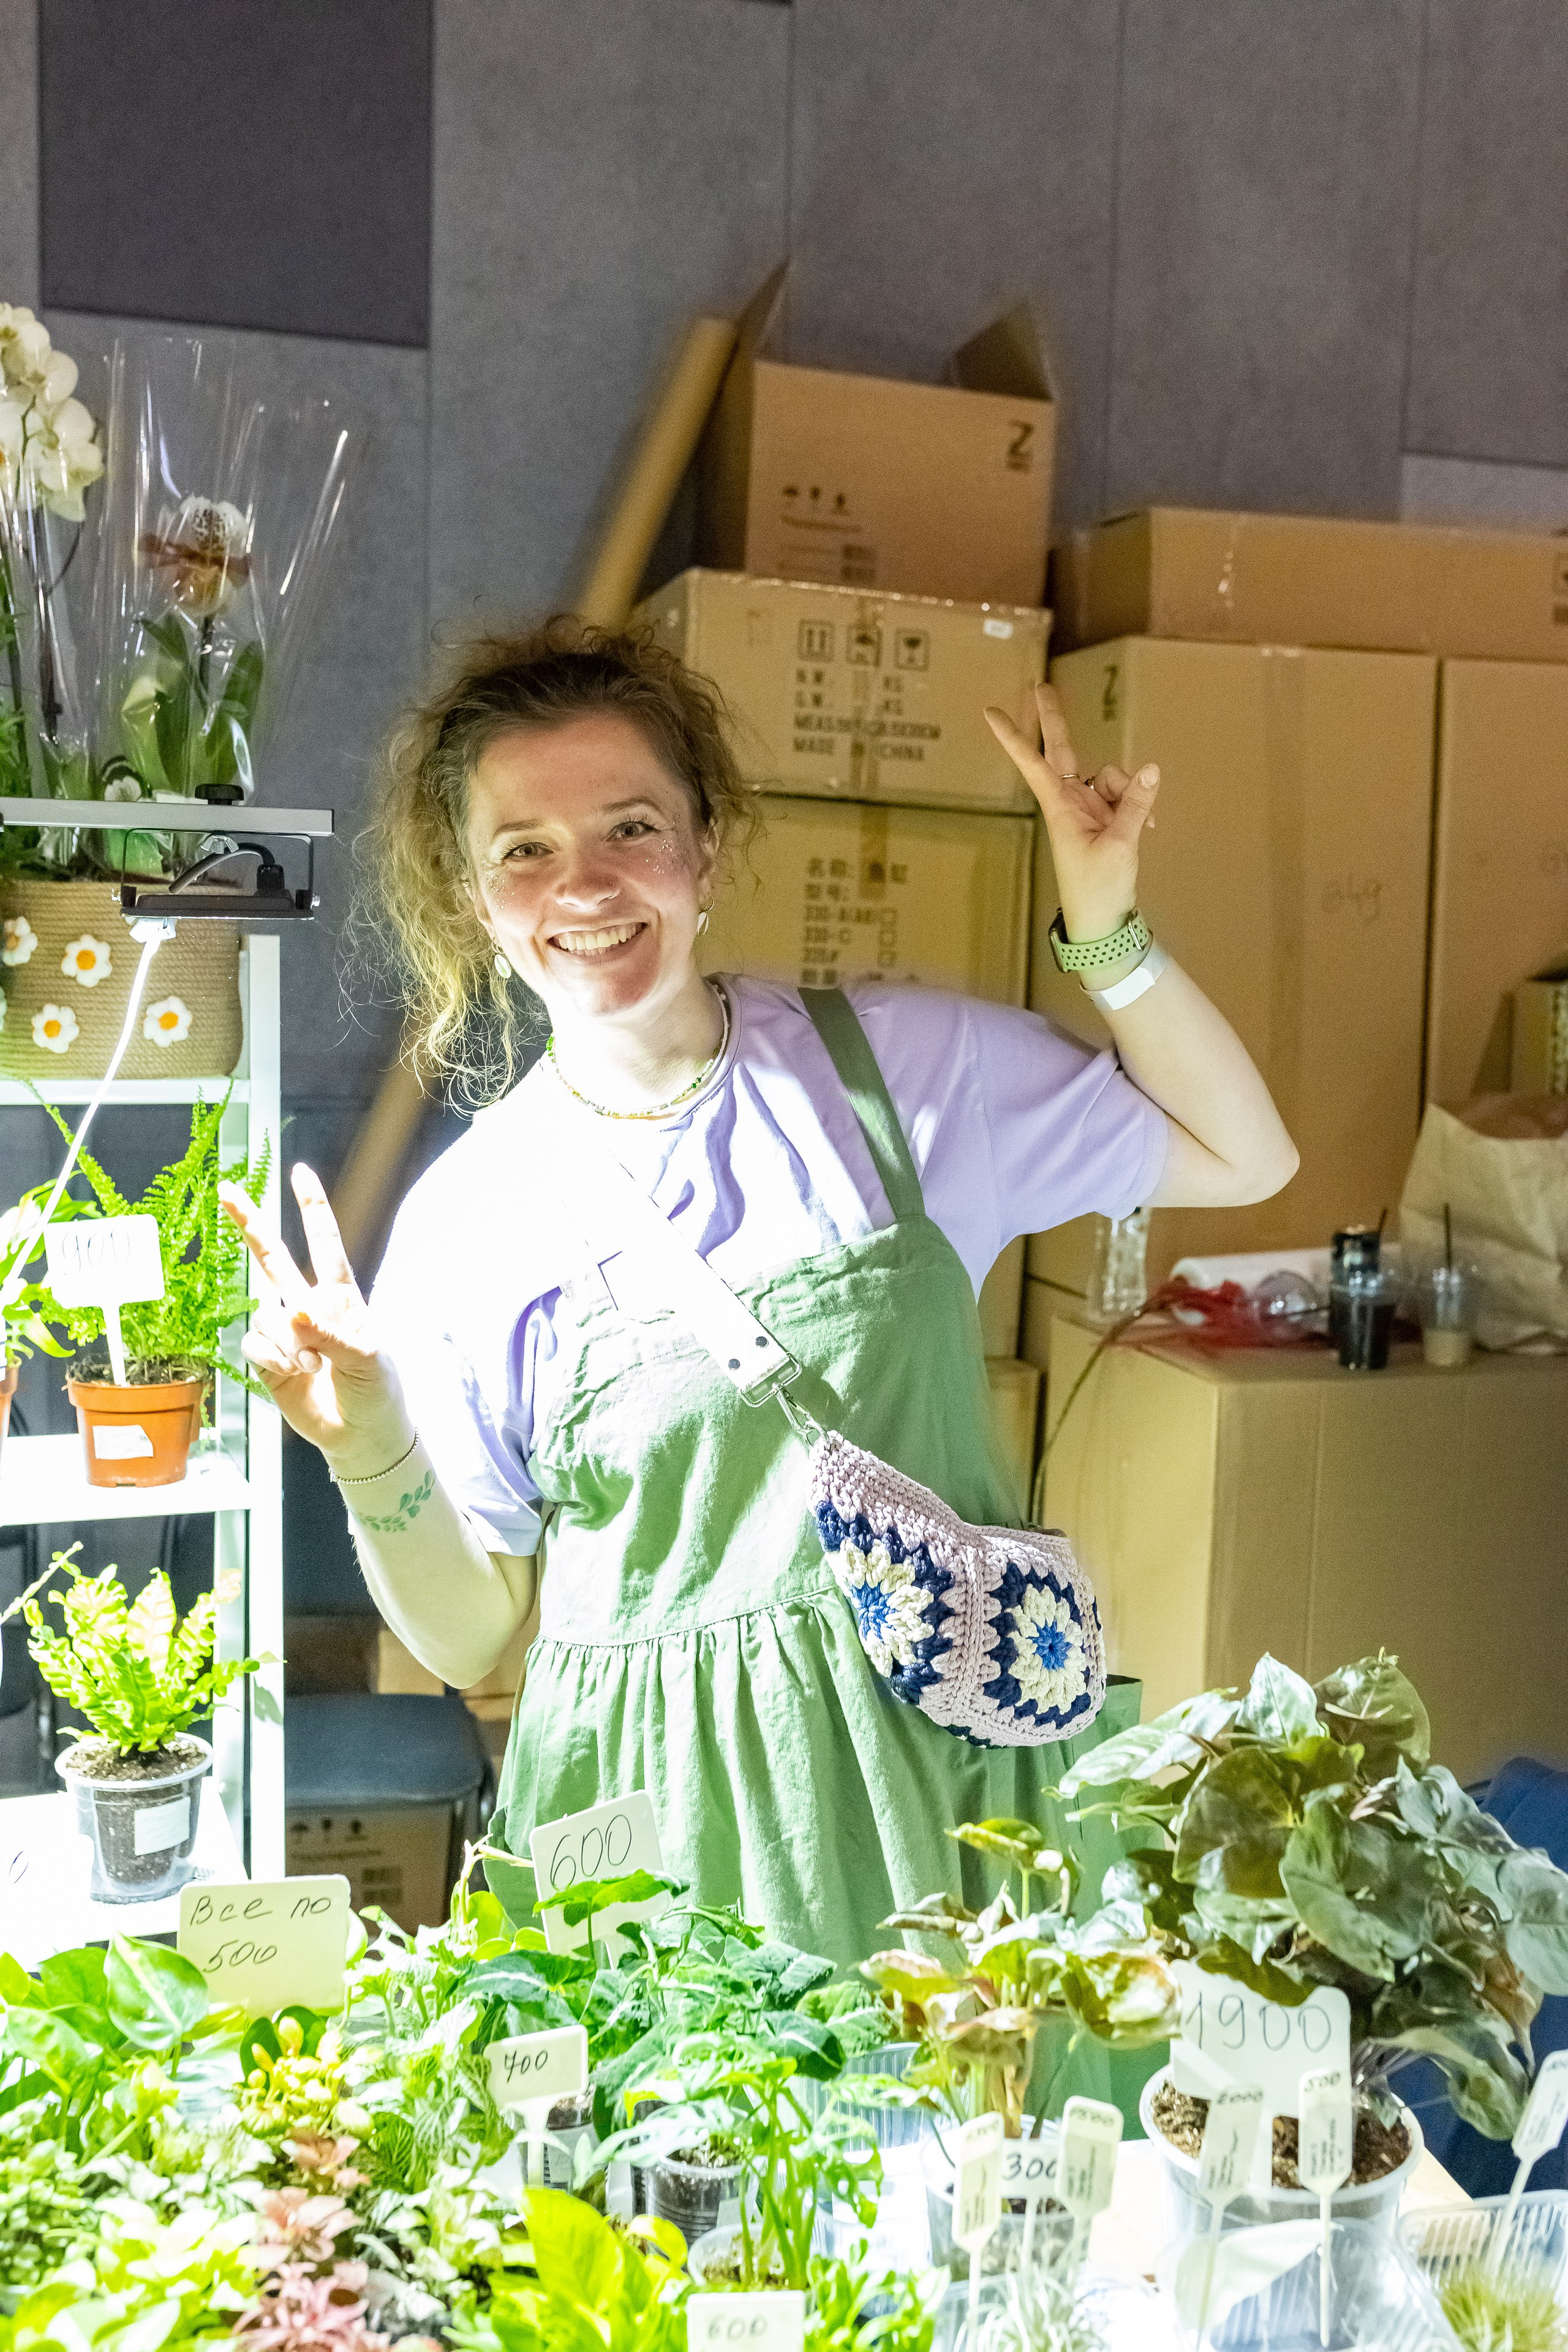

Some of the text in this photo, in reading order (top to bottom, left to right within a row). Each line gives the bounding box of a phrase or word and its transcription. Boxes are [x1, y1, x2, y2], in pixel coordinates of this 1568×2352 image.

[550, 1814, 632, 1891] 600
[190, 1894, 273, 1927] Все
[203, 1939, 278, 1973] 500
[1186, 1992, 1332, 2052] 1900
[706, 2313, 769, 2341] 600
